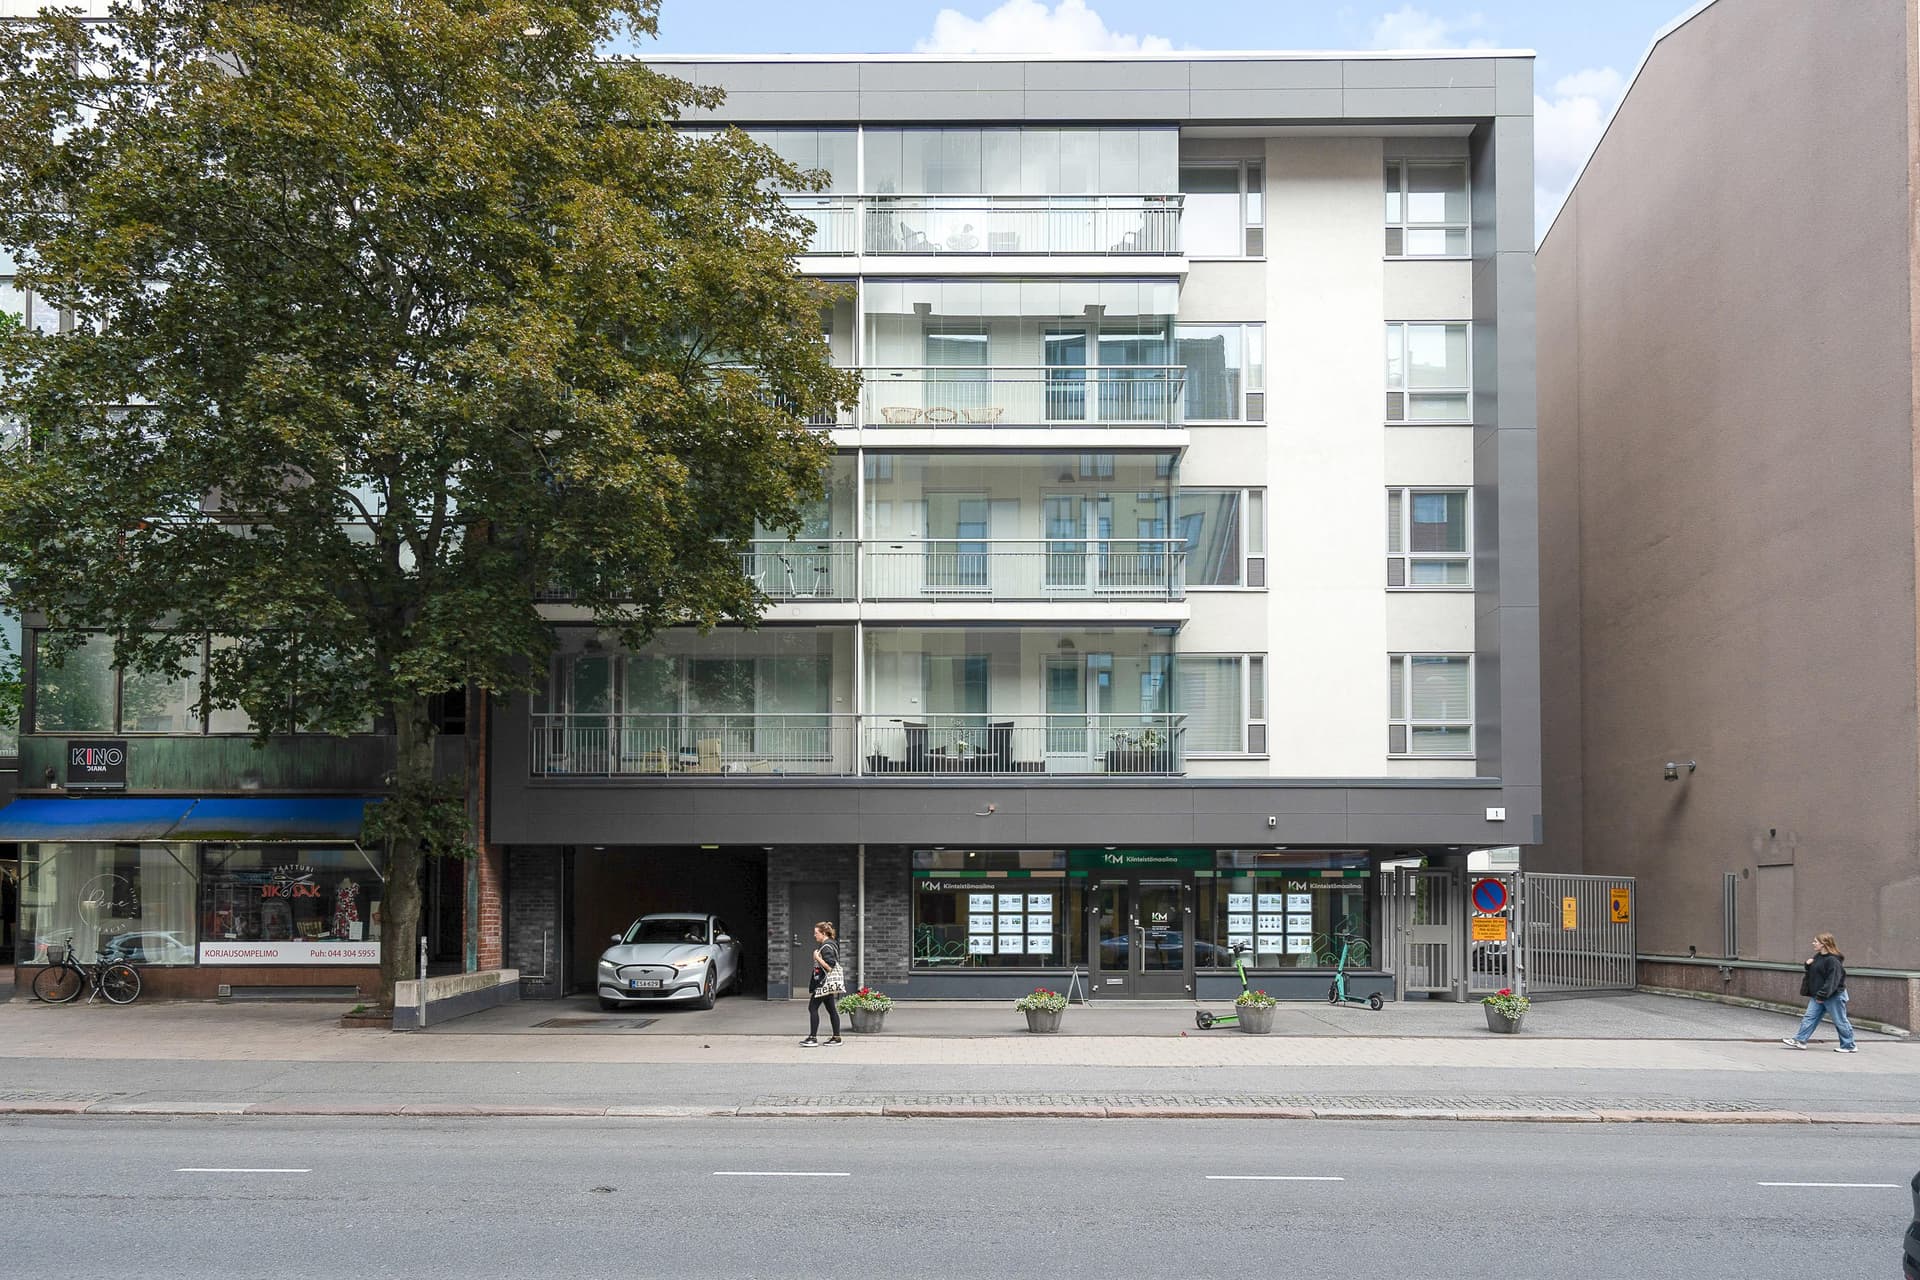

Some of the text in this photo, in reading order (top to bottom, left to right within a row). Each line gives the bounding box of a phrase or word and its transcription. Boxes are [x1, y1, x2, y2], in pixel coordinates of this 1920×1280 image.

[72, 747, 123, 766] KINO
[1104, 854, 1123, 864] KM
[921, 881, 941, 891] KM
[1288, 881, 1307, 891] KM
[1151, 912, 1168, 921] KM
[204, 950, 279, 958] KORJAUSOMPELIMO
[310, 949, 376, 958] Puh: 044 304 5955
